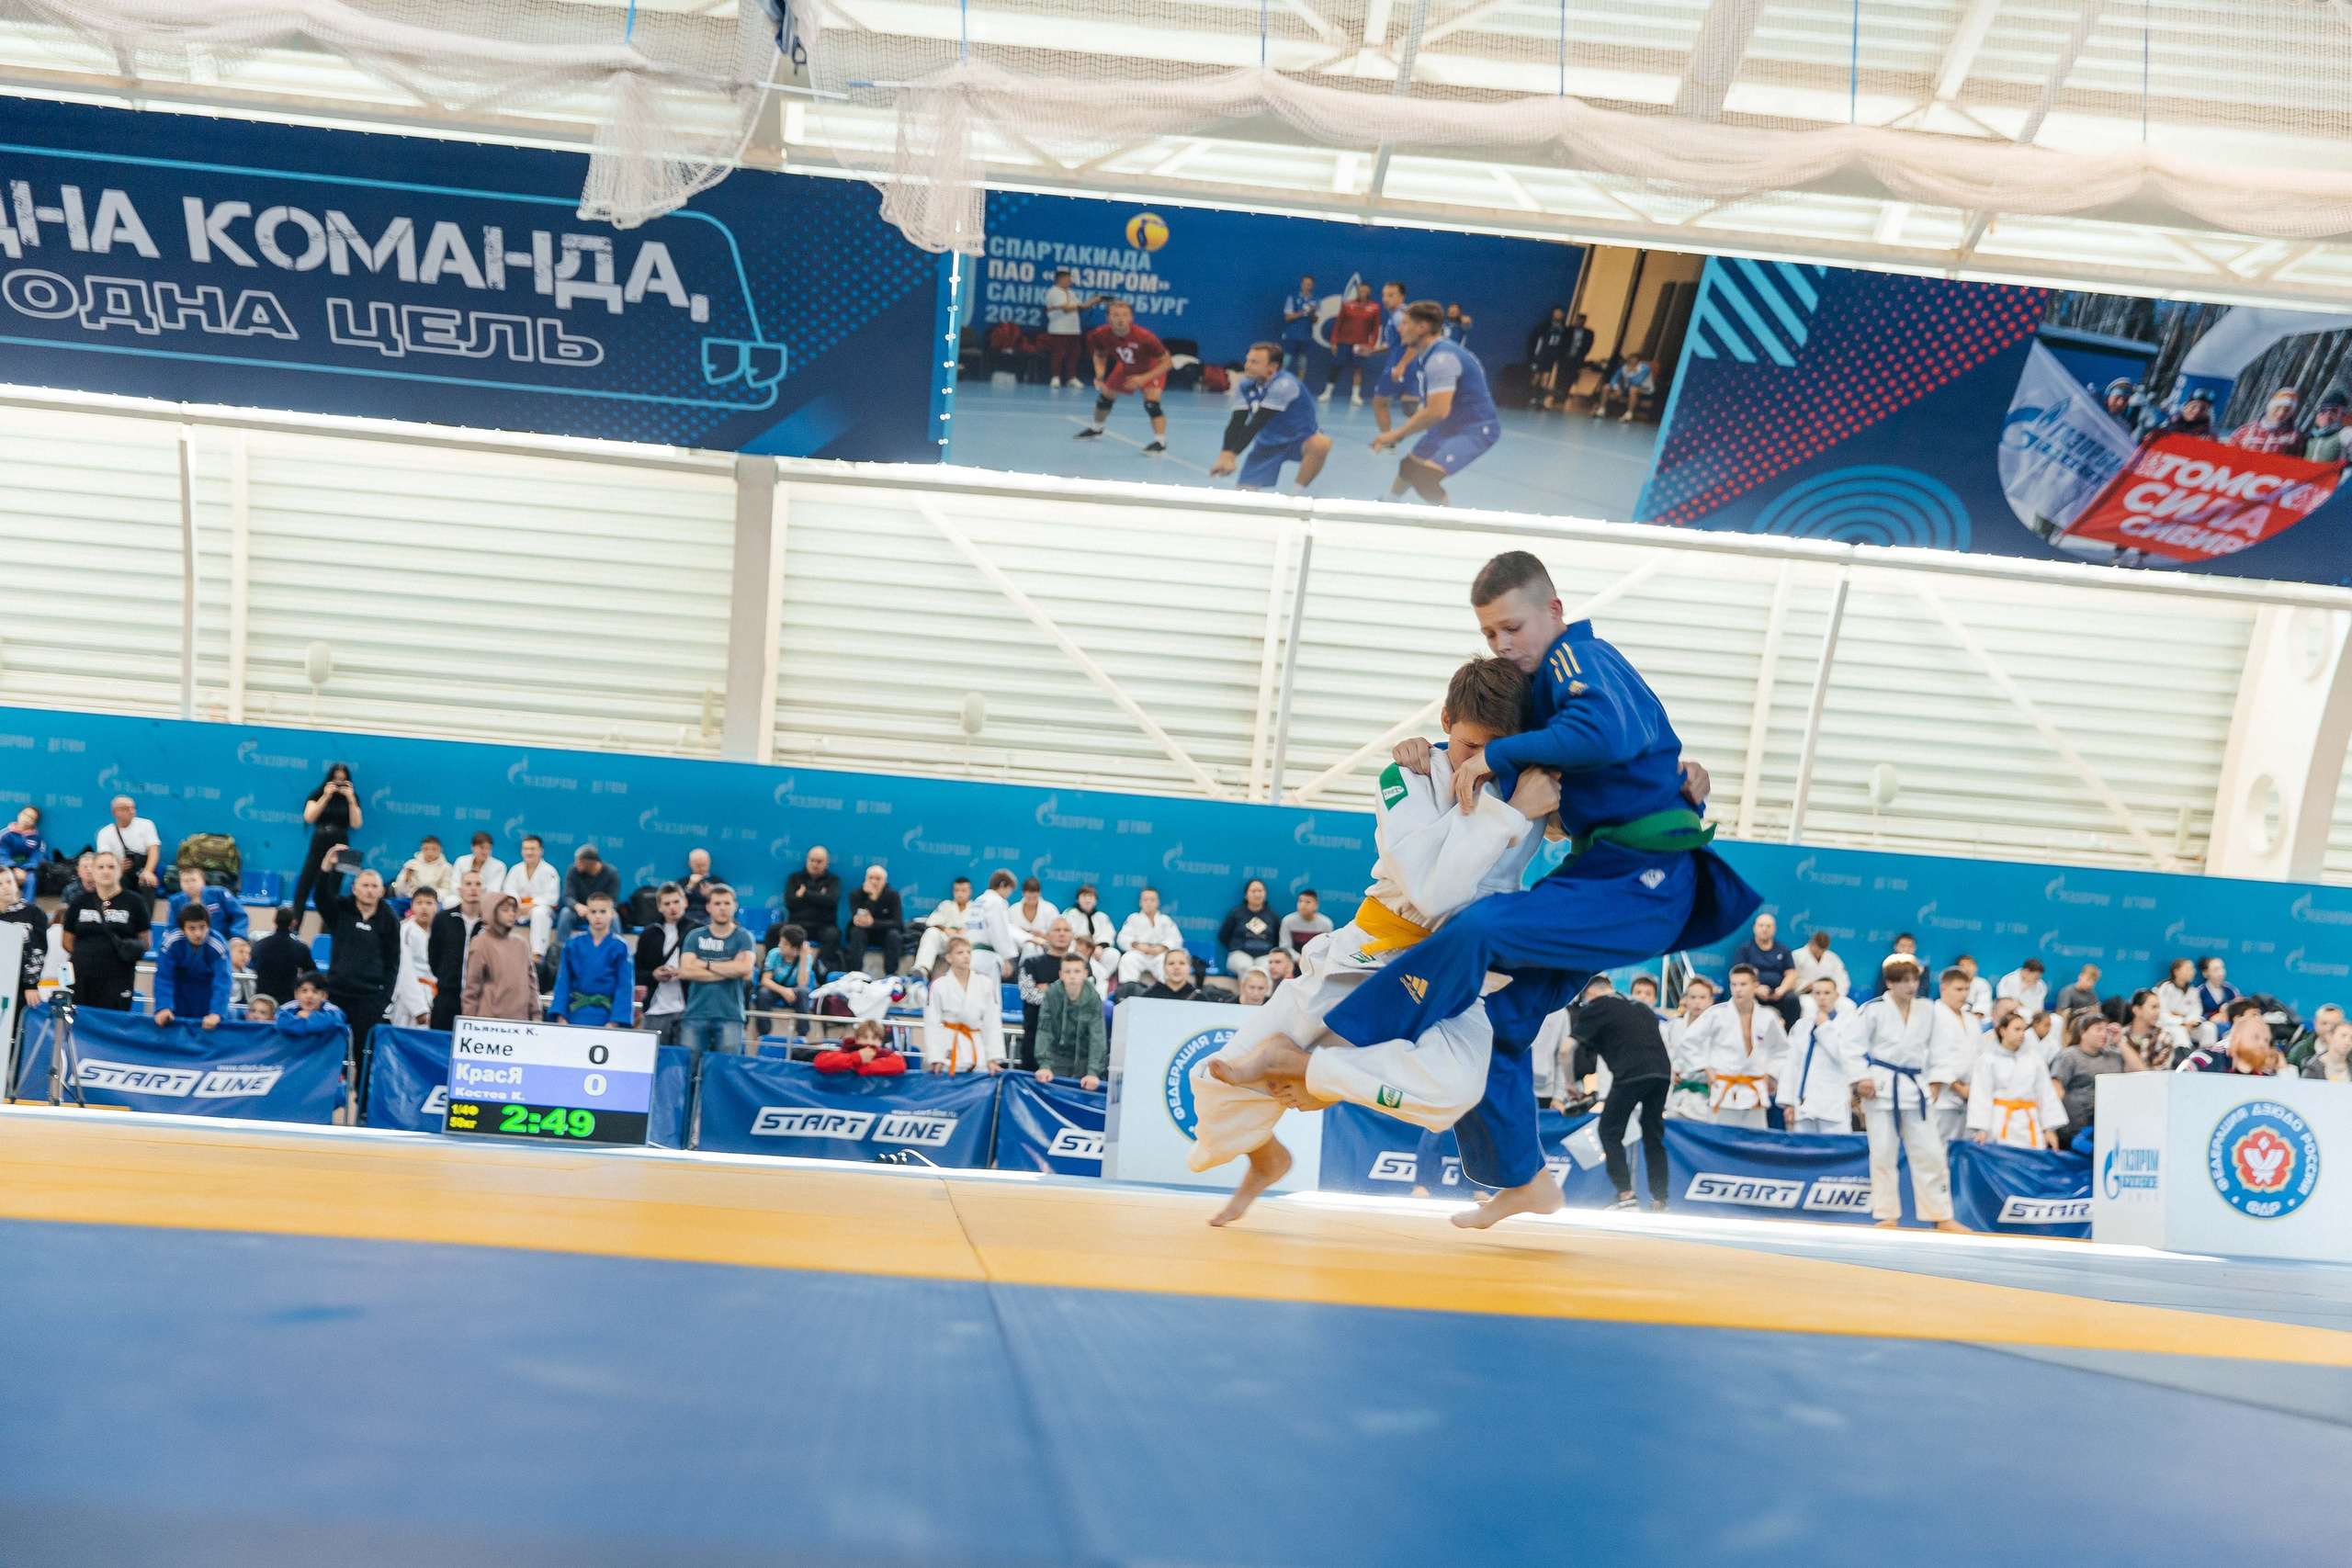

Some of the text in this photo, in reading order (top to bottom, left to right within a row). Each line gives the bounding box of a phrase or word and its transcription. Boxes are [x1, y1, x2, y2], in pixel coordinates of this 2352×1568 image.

[183, 196, 710, 323] КОМАНДА,
[989, 234, 1150, 272] СПАРТАКИАДА
[988, 259, 1035, 283] ПАО
[2, 268, 605, 367] ОДНА ЦЕЛЬ
[985, 303, 1041, 327] 2022
[2122, 480, 2272, 539] СИЛА
[2120, 514, 2256, 555] СИБИР
[459, 1037, 609, 1065] Кеме 0
[79, 1065, 270, 1092] START LINE
[455, 1062, 607, 1097] КрасЯ 0
[1167, 1034, 1210, 1121] ФЕДЕРАЦИЯ
[499, 1104, 595, 1138] 2:49
[760, 1112, 946, 1141] START LINE
[2251, 1102, 2304, 1133] ДЗЮДО
[2297, 1132, 2319, 1196] РОССИИ
[1695, 1179, 1871, 1206] START LINE
[2008, 1202, 2090, 1217] STAR
[2245, 1200, 2282, 1217] ФДР
